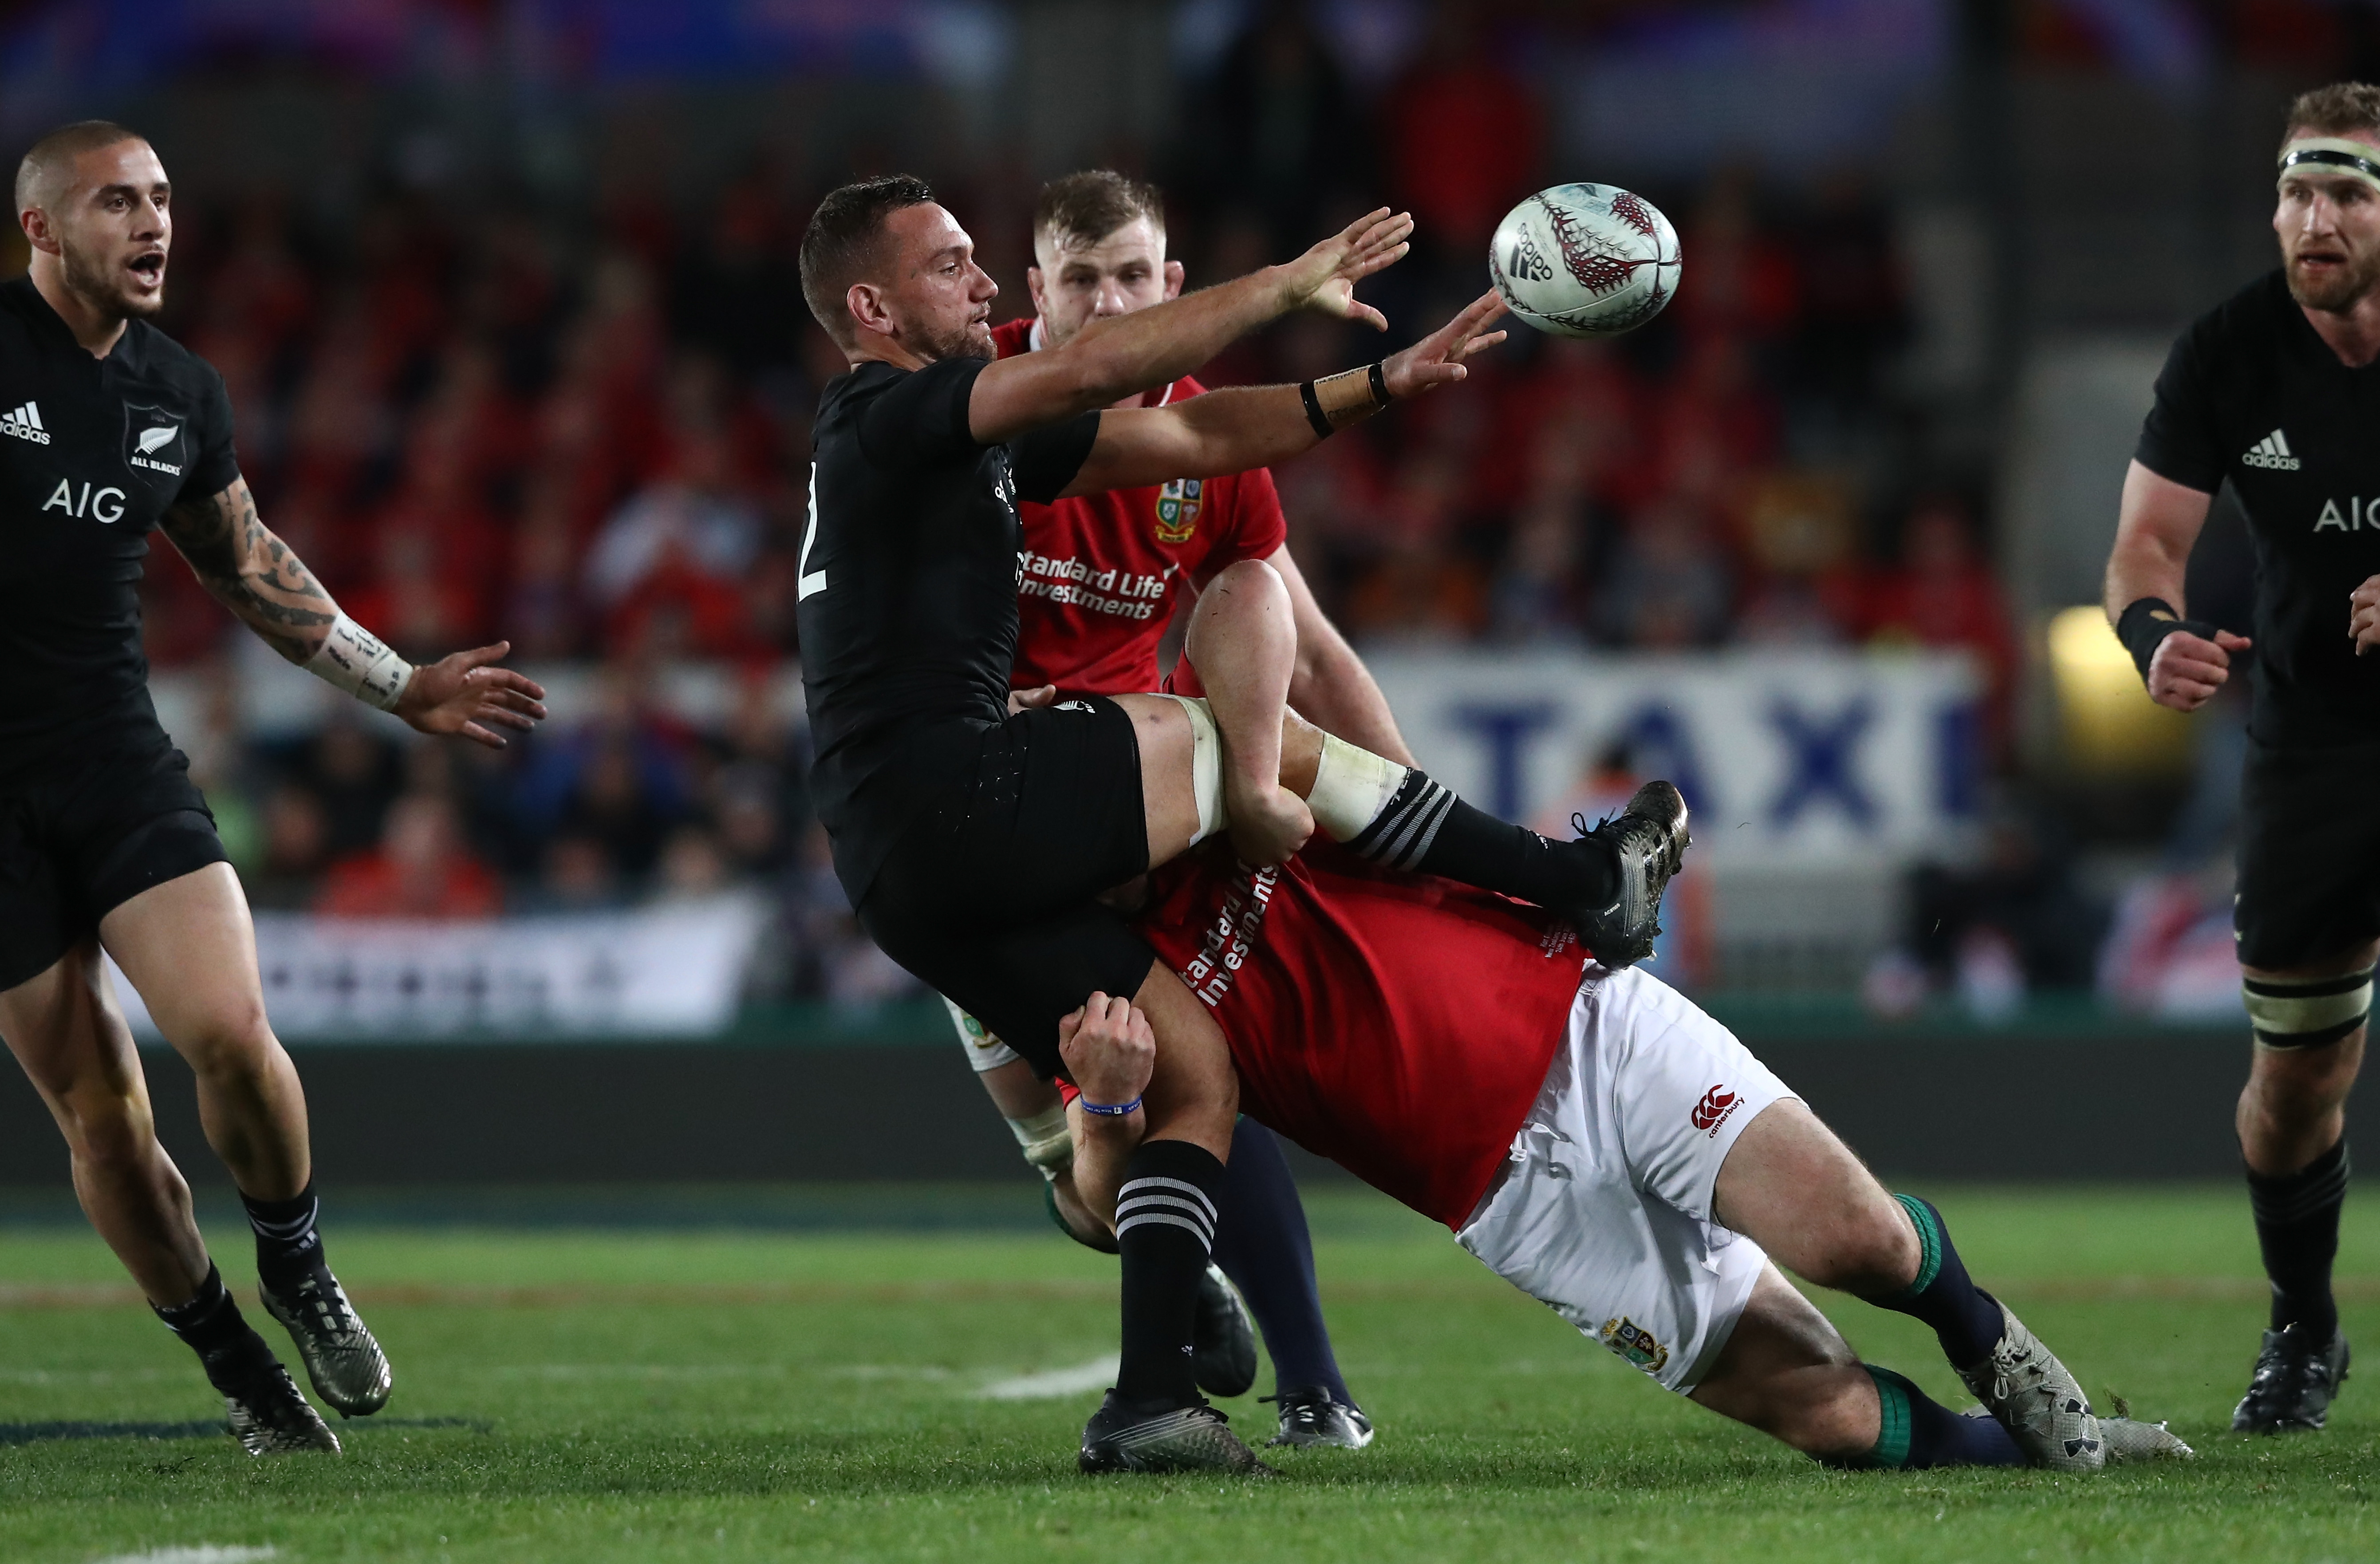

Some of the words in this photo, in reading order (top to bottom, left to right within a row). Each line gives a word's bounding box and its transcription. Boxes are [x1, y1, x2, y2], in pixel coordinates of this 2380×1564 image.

[1517, 222, 1553, 280] adidas
[131, 456, 149, 468] ALL
[150, 460, 181, 476] BLACKS
[2242, 452, 2300, 471] adidas
[42, 478, 126, 523] AIG
[1022, 550, 1117, 591] tandard
[1119, 573, 1165, 599] Life
[1020, 577, 1155, 620] nvestments
[1178, 891, 1241, 989] tandard
[1197, 864, 1280, 1007] Investments
[1709, 1097, 1745, 1138] canterbury
